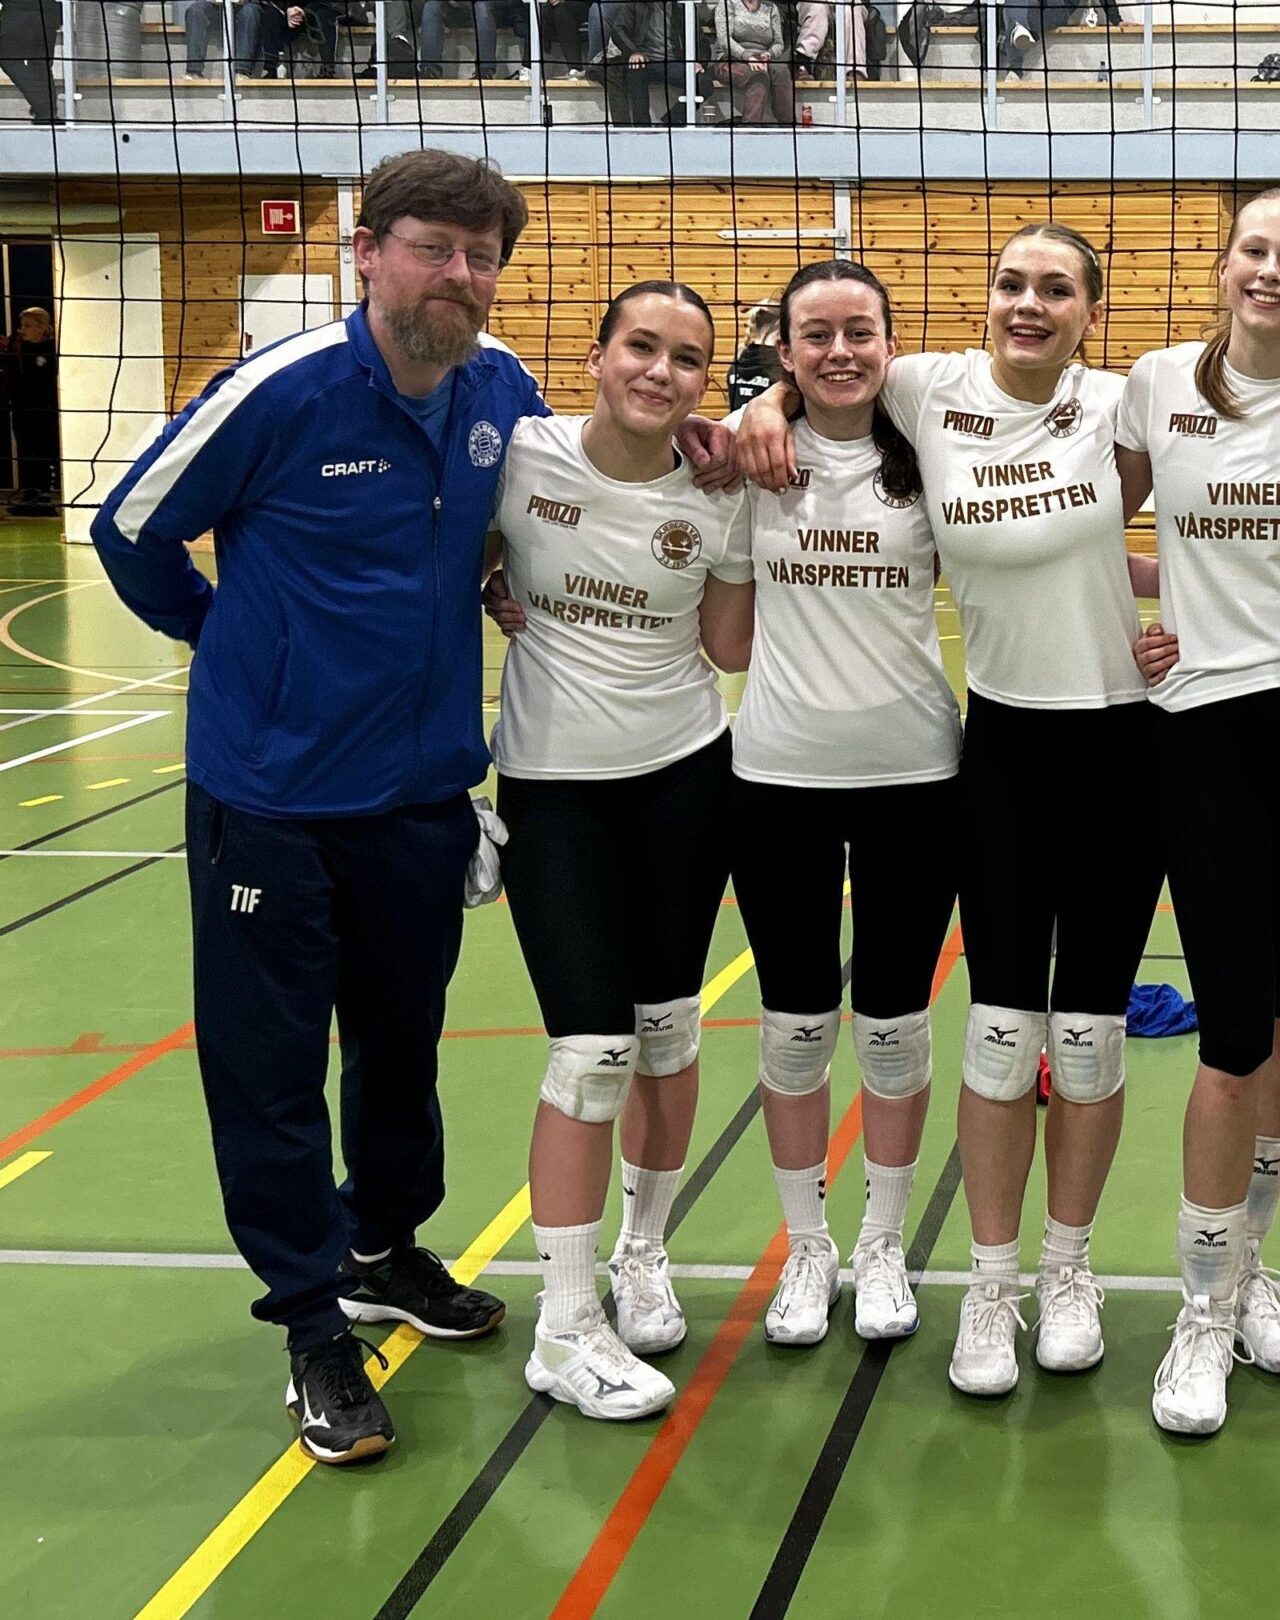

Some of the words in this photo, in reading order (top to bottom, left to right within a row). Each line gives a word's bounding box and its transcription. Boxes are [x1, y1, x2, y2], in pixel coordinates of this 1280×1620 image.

[321, 460, 376, 477] CRAFT
[972, 460, 1055, 488] VINNER
[942, 482, 1098, 525] VÅRSPRETTEN
[797, 528, 880, 554] VINNER
[766, 558, 909, 589] VÅRSPRETTEN
[564, 573, 649, 609] VINNER
[230, 884, 262, 914] TIF
